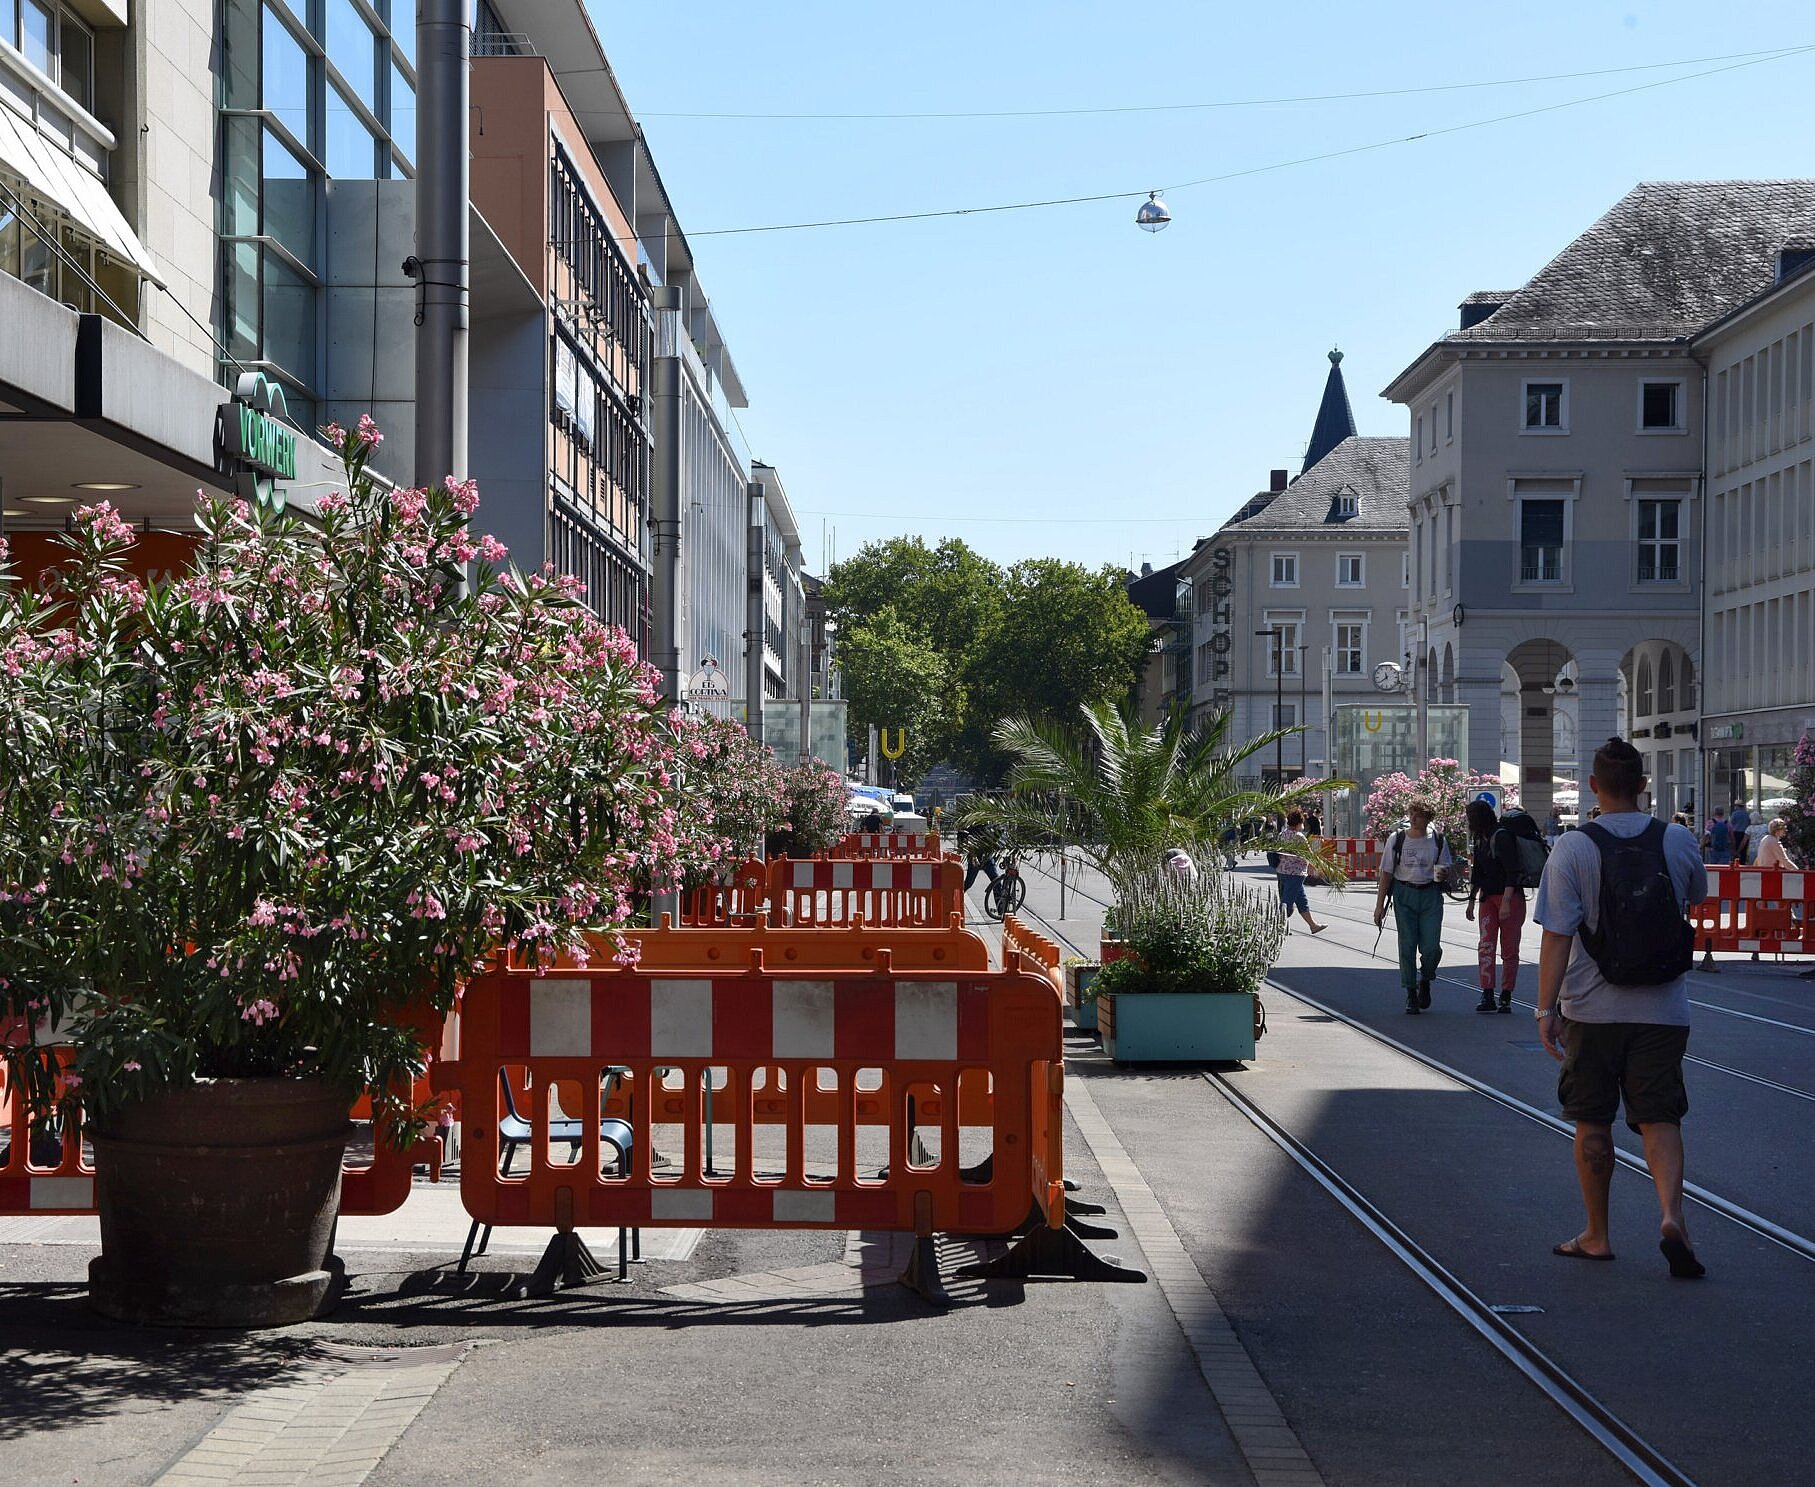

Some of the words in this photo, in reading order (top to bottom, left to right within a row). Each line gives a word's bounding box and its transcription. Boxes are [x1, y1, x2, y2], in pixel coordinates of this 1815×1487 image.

[239, 402, 297, 480] VORWERK
[1364, 710, 1382, 733] U
[882, 728, 904, 759] U
